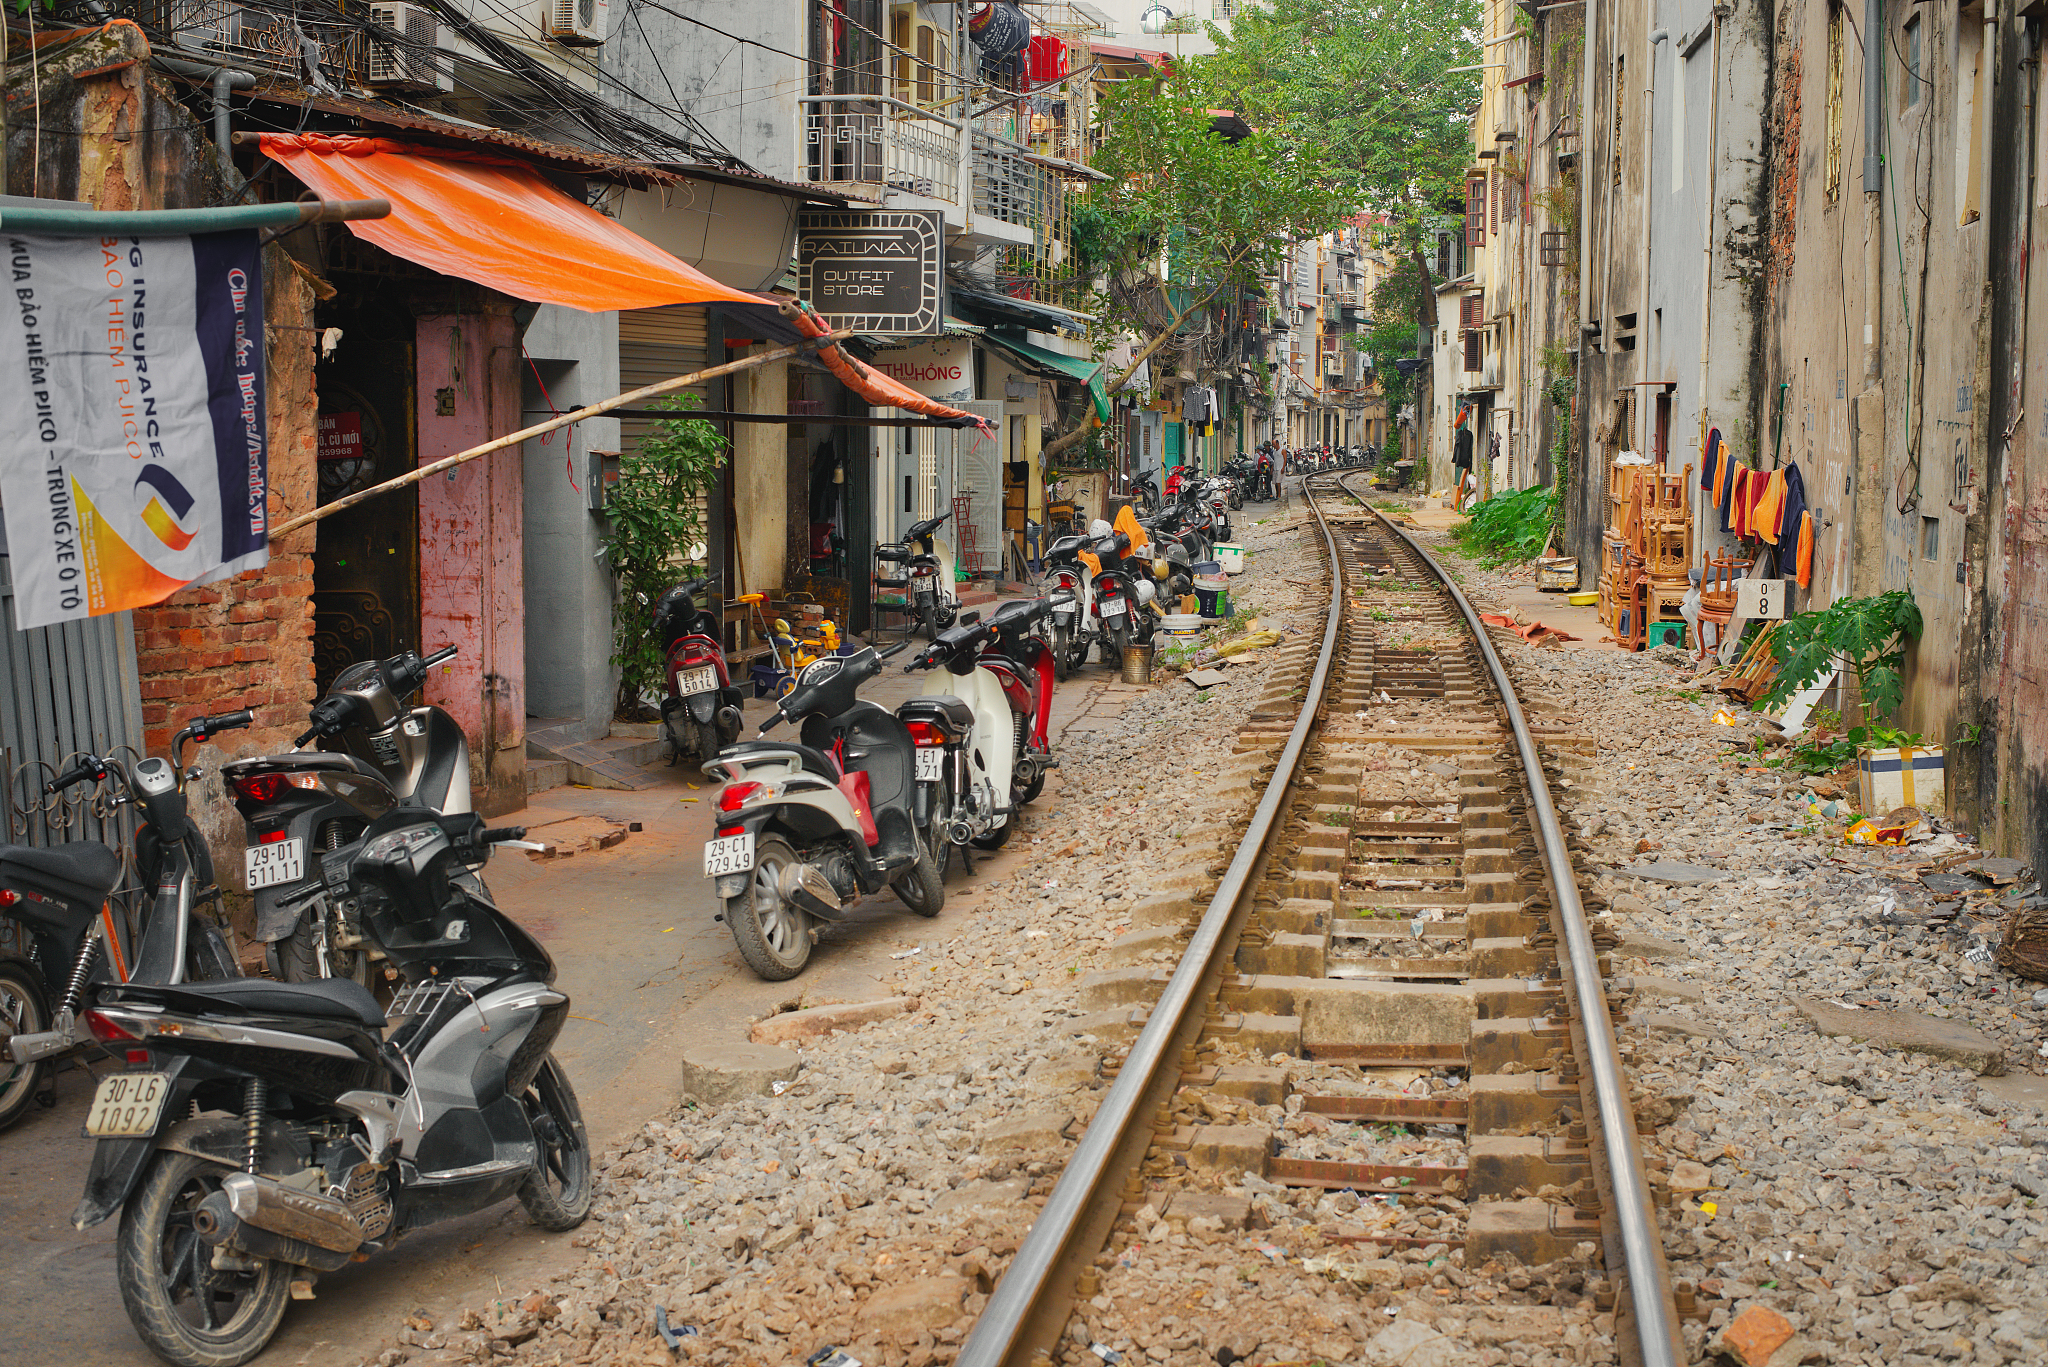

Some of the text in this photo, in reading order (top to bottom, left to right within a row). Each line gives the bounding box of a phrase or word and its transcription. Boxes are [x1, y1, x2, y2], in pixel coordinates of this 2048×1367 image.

[9, 238, 31, 282] MUA
[801, 241, 920, 255] RAILWAY
[823, 271, 894, 281] OUTFIT
[823, 285, 884, 295] STORE
[16, 288, 41, 328] BẢO
[25, 333, 49, 385] HIỂM
[132, 278, 165, 458] INSURANCE
[872, 362, 914, 377] THU
[34, 390, 58, 443] PJICO
[115, 379, 142, 460] PJICO
[55, 538, 76, 564] XE
[58, 567, 81, 581] Ô
[60, 584, 83, 611] TÔ
[1761, 583, 1768, 595] 0
[1759, 598, 1769, 615] 8
[683, 669, 711, 682] 29-T2
[685, 679, 712, 692] 5014
[253, 842, 293, 867] 29-D1
[711, 836, 746, 857] 29-C1
[249, 860, 299, 887] 511.11
[707, 853, 750, 876] 229.49
[104, 1077, 160, 1103] 30-L6
[97, 1107, 150, 1132] 1092
